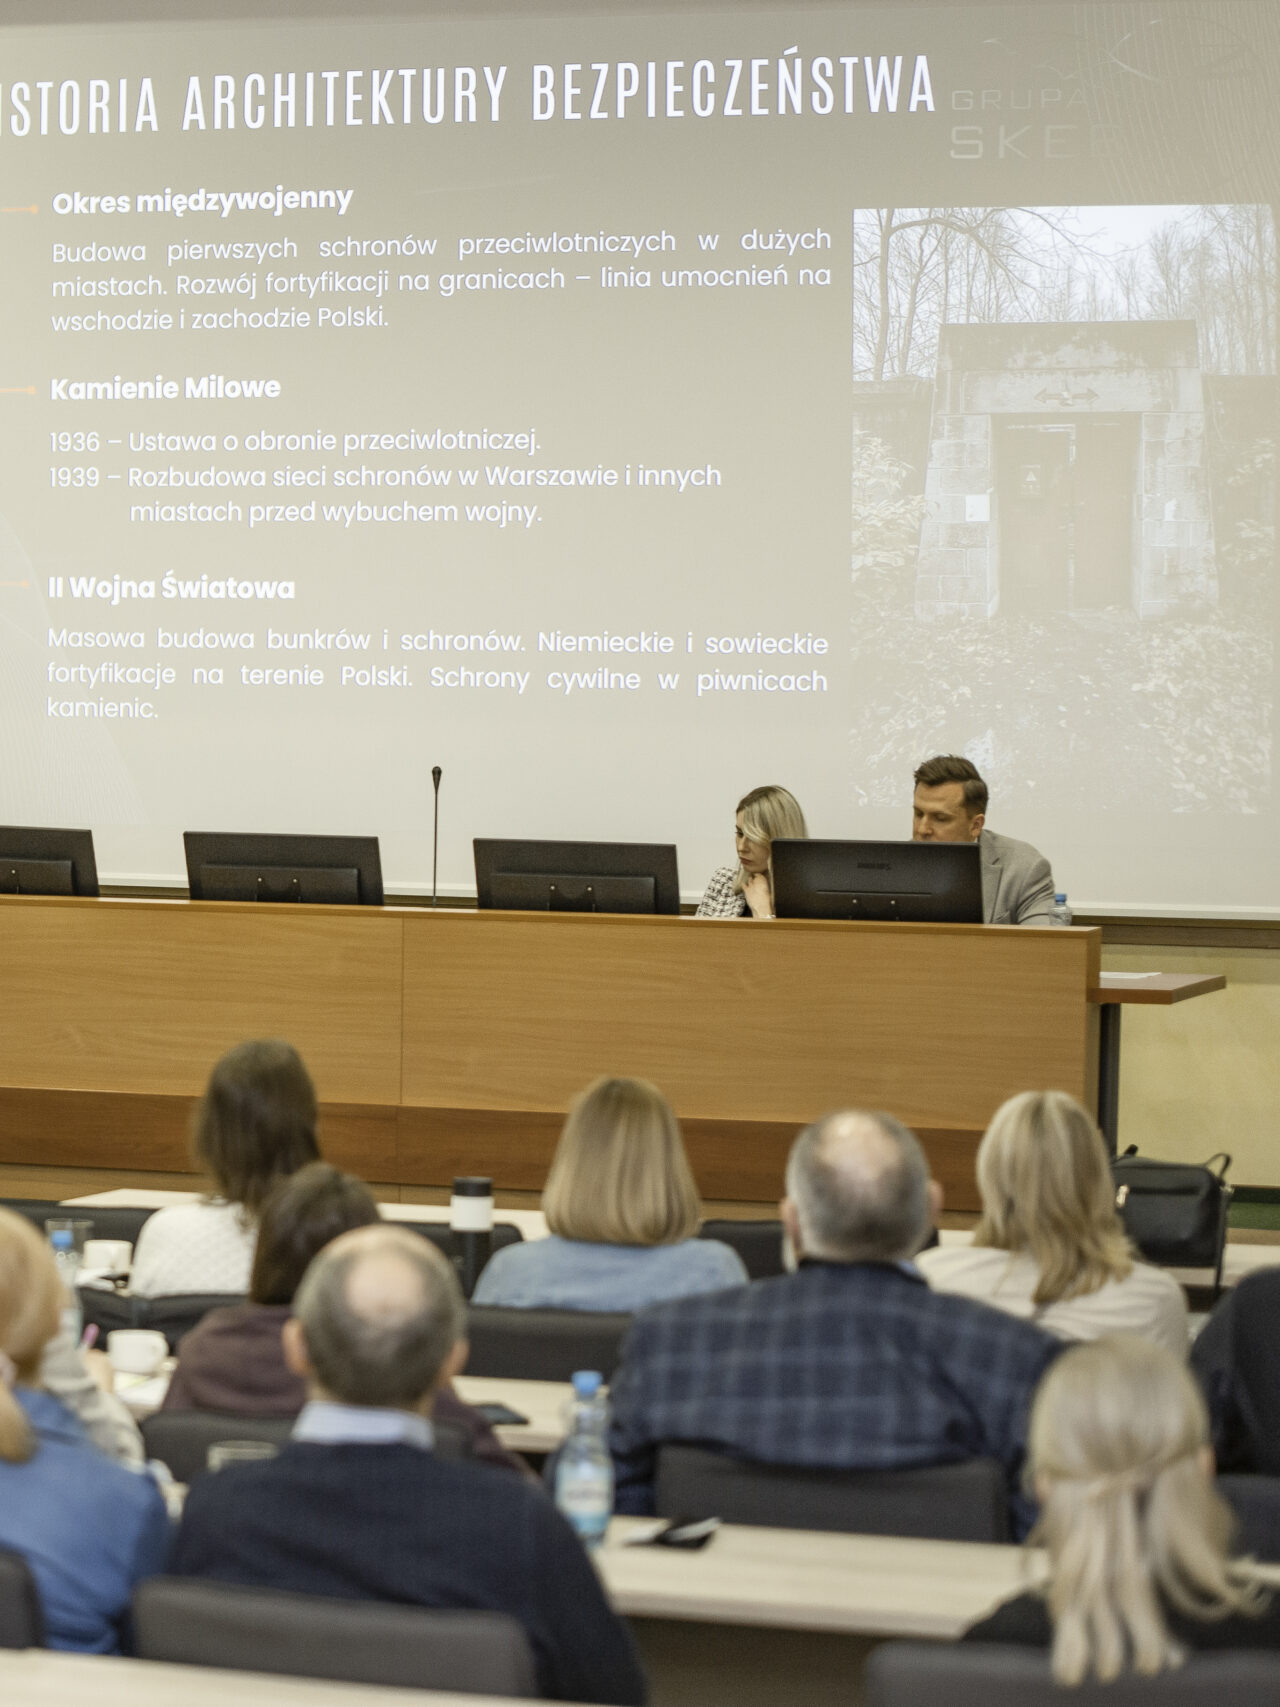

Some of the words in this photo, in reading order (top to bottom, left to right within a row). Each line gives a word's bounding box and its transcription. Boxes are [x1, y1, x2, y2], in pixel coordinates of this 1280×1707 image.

[182, 66, 507, 131] ARCHITEKTURY
[533, 45, 936, 120] BEZPIECZEŃSTWA
[53, 192, 131, 214] Okres
[136, 185, 354, 218] międzywojenny
[53, 241, 146, 263] Budowa
[168, 237, 297, 267] pierwszych
[320, 234, 437, 257] schronów
[459, 230, 676, 261] przeciwlotniczych
[698, 234, 719, 250] w
[741, 228, 831, 256] dużych
[53, 274, 167, 296] miastach.
[177, 272, 256, 300] Rozwój
[265, 270, 389, 299] fortyfikacji
[399, 275, 429, 290] na
[439, 268, 564, 297] granicach
[602, 266, 651, 288] linia
[662, 264, 788, 287] umocnień
[799, 268, 831, 285] na
[51, 309, 173, 331] wschodzie
[180, 308, 184, 328] i
[192, 307, 311, 329] zachodzie
[318, 305, 388, 327] Polski.
[51, 374, 179, 400] Kamienie
[185, 374, 281, 398] Milowe
[50, 432, 99, 452] 1936
[129, 432, 216, 451] Ustawa
[223, 435, 238, 451] o
[245, 429, 336, 451] obronie
[344, 428, 541, 456] przeciwlotniczej.
[50, 467, 99, 487] 1939
[129, 466, 265, 487] Rozbudowa
[273, 465, 326, 486] sieci
[333, 464, 452, 486] schronów
[458, 470, 479, 485] w
[485, 464, 618, 486] Warszawie
[626, 464, 630, 485] i
[638, 464, 721, 492] innych
[131, 501, 241, 521] miastach
[250, 501, 315, 528] przed
[322, 500, 458, 528] wybuchem
[465, 500, 542, 528] wojny.
[49, 577, 63, 598] II
[69, 574, 155, 605] Wojna
[162, 569, 295, 599] Światowa
[48, 628, 144, 648] Masowa
[158, 627, 254, 648] budowa
[268, 628, 370, 650] bunkrów
[383, 629, 388, 650] i
[400, 629, 525, 651] schronów.
[538, 630, 674, 653] Niemieckie
[687, 632, 693, 653] i
[706, 632, 828, 654] sowieckie
[48, 662, 175, 690] fortyfikacje
[193, 668, 223, 684] na
[240, 664, 323, 685] terenie
[342, 665, 412, 686] Polski.
[430, 666, 530, 694] Schrony
[547, 668, 640, 695] cywilne
[658, 674, 679, 689] w
[697, 668, 827, 696] piwnicach
[48, 696, 157, 718] kamienic.
